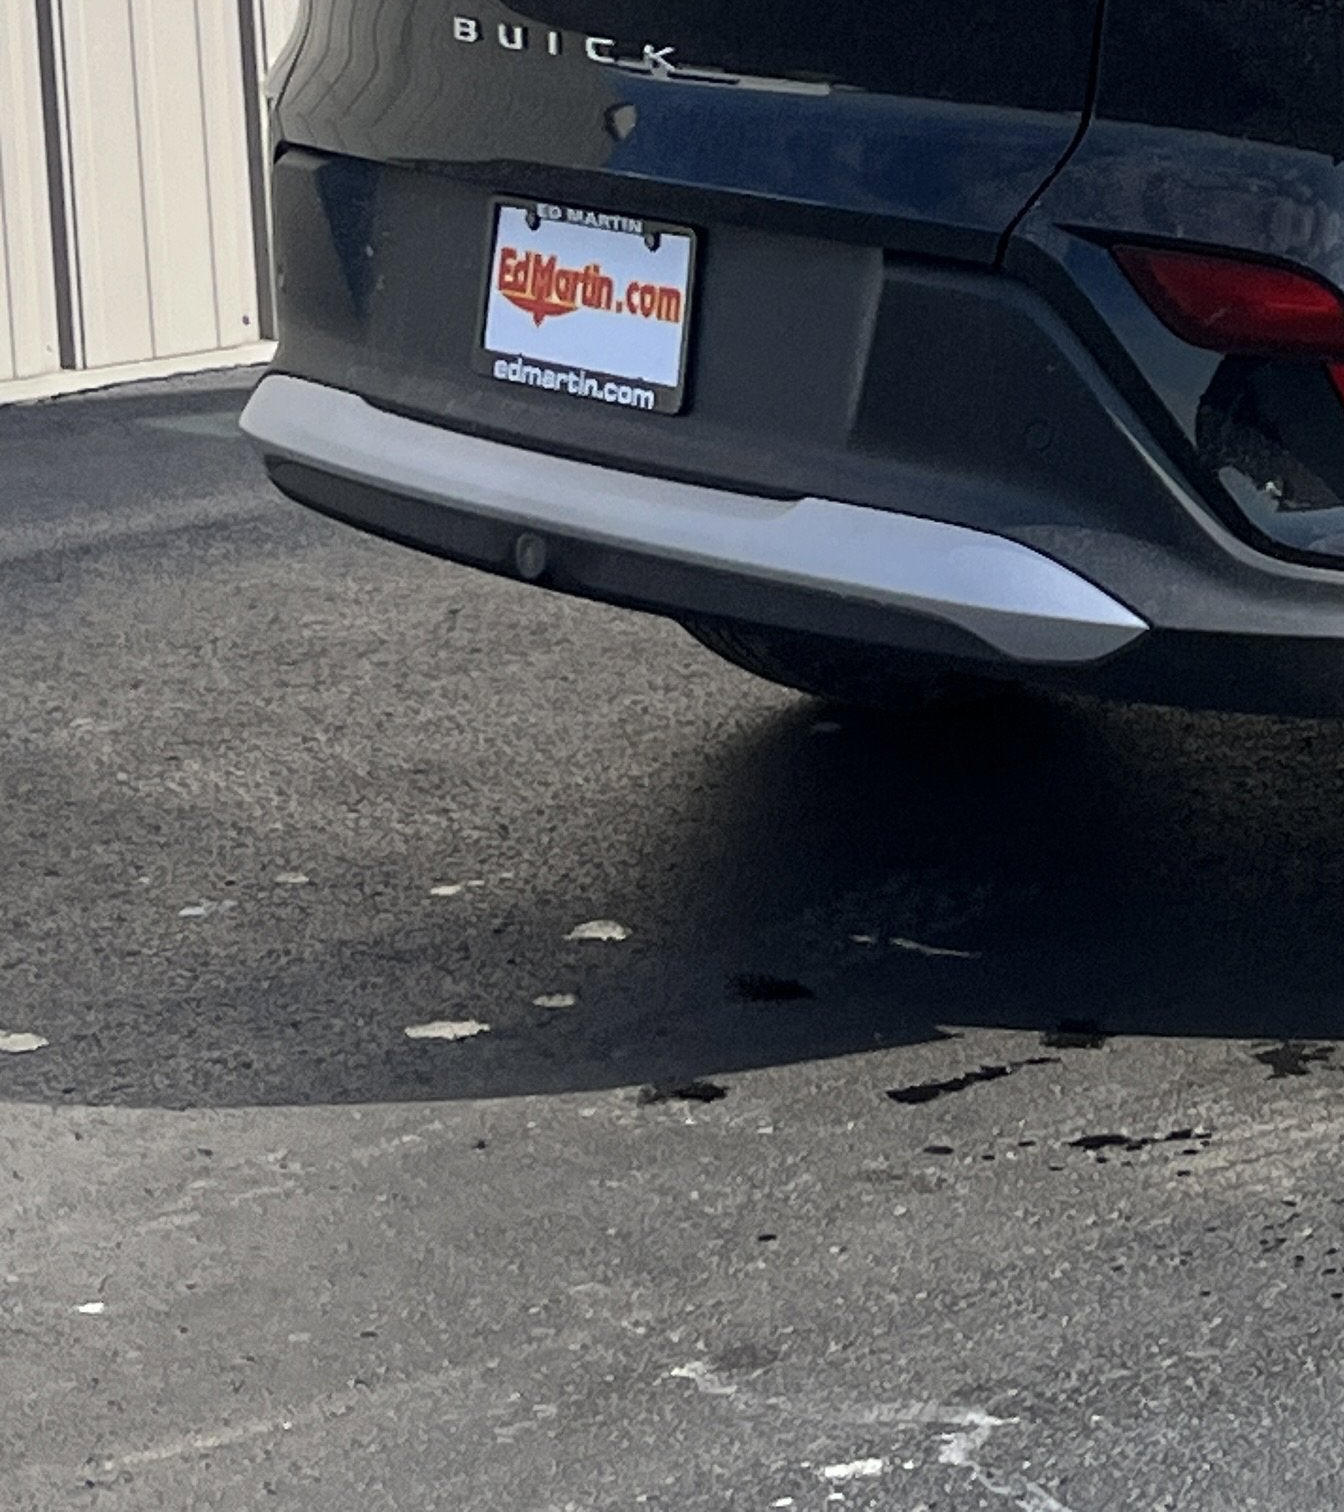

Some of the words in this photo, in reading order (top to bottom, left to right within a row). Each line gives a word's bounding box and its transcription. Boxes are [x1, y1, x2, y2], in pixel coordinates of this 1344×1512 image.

[453, 16, 677, 71] BUICK
[536, 202, 562, 219] ED
[567, 208, 643, 234] MARTIN
[498, 247, 682, 324] EdMartin.com
[493, 358, 655, 410] edmartin.com
